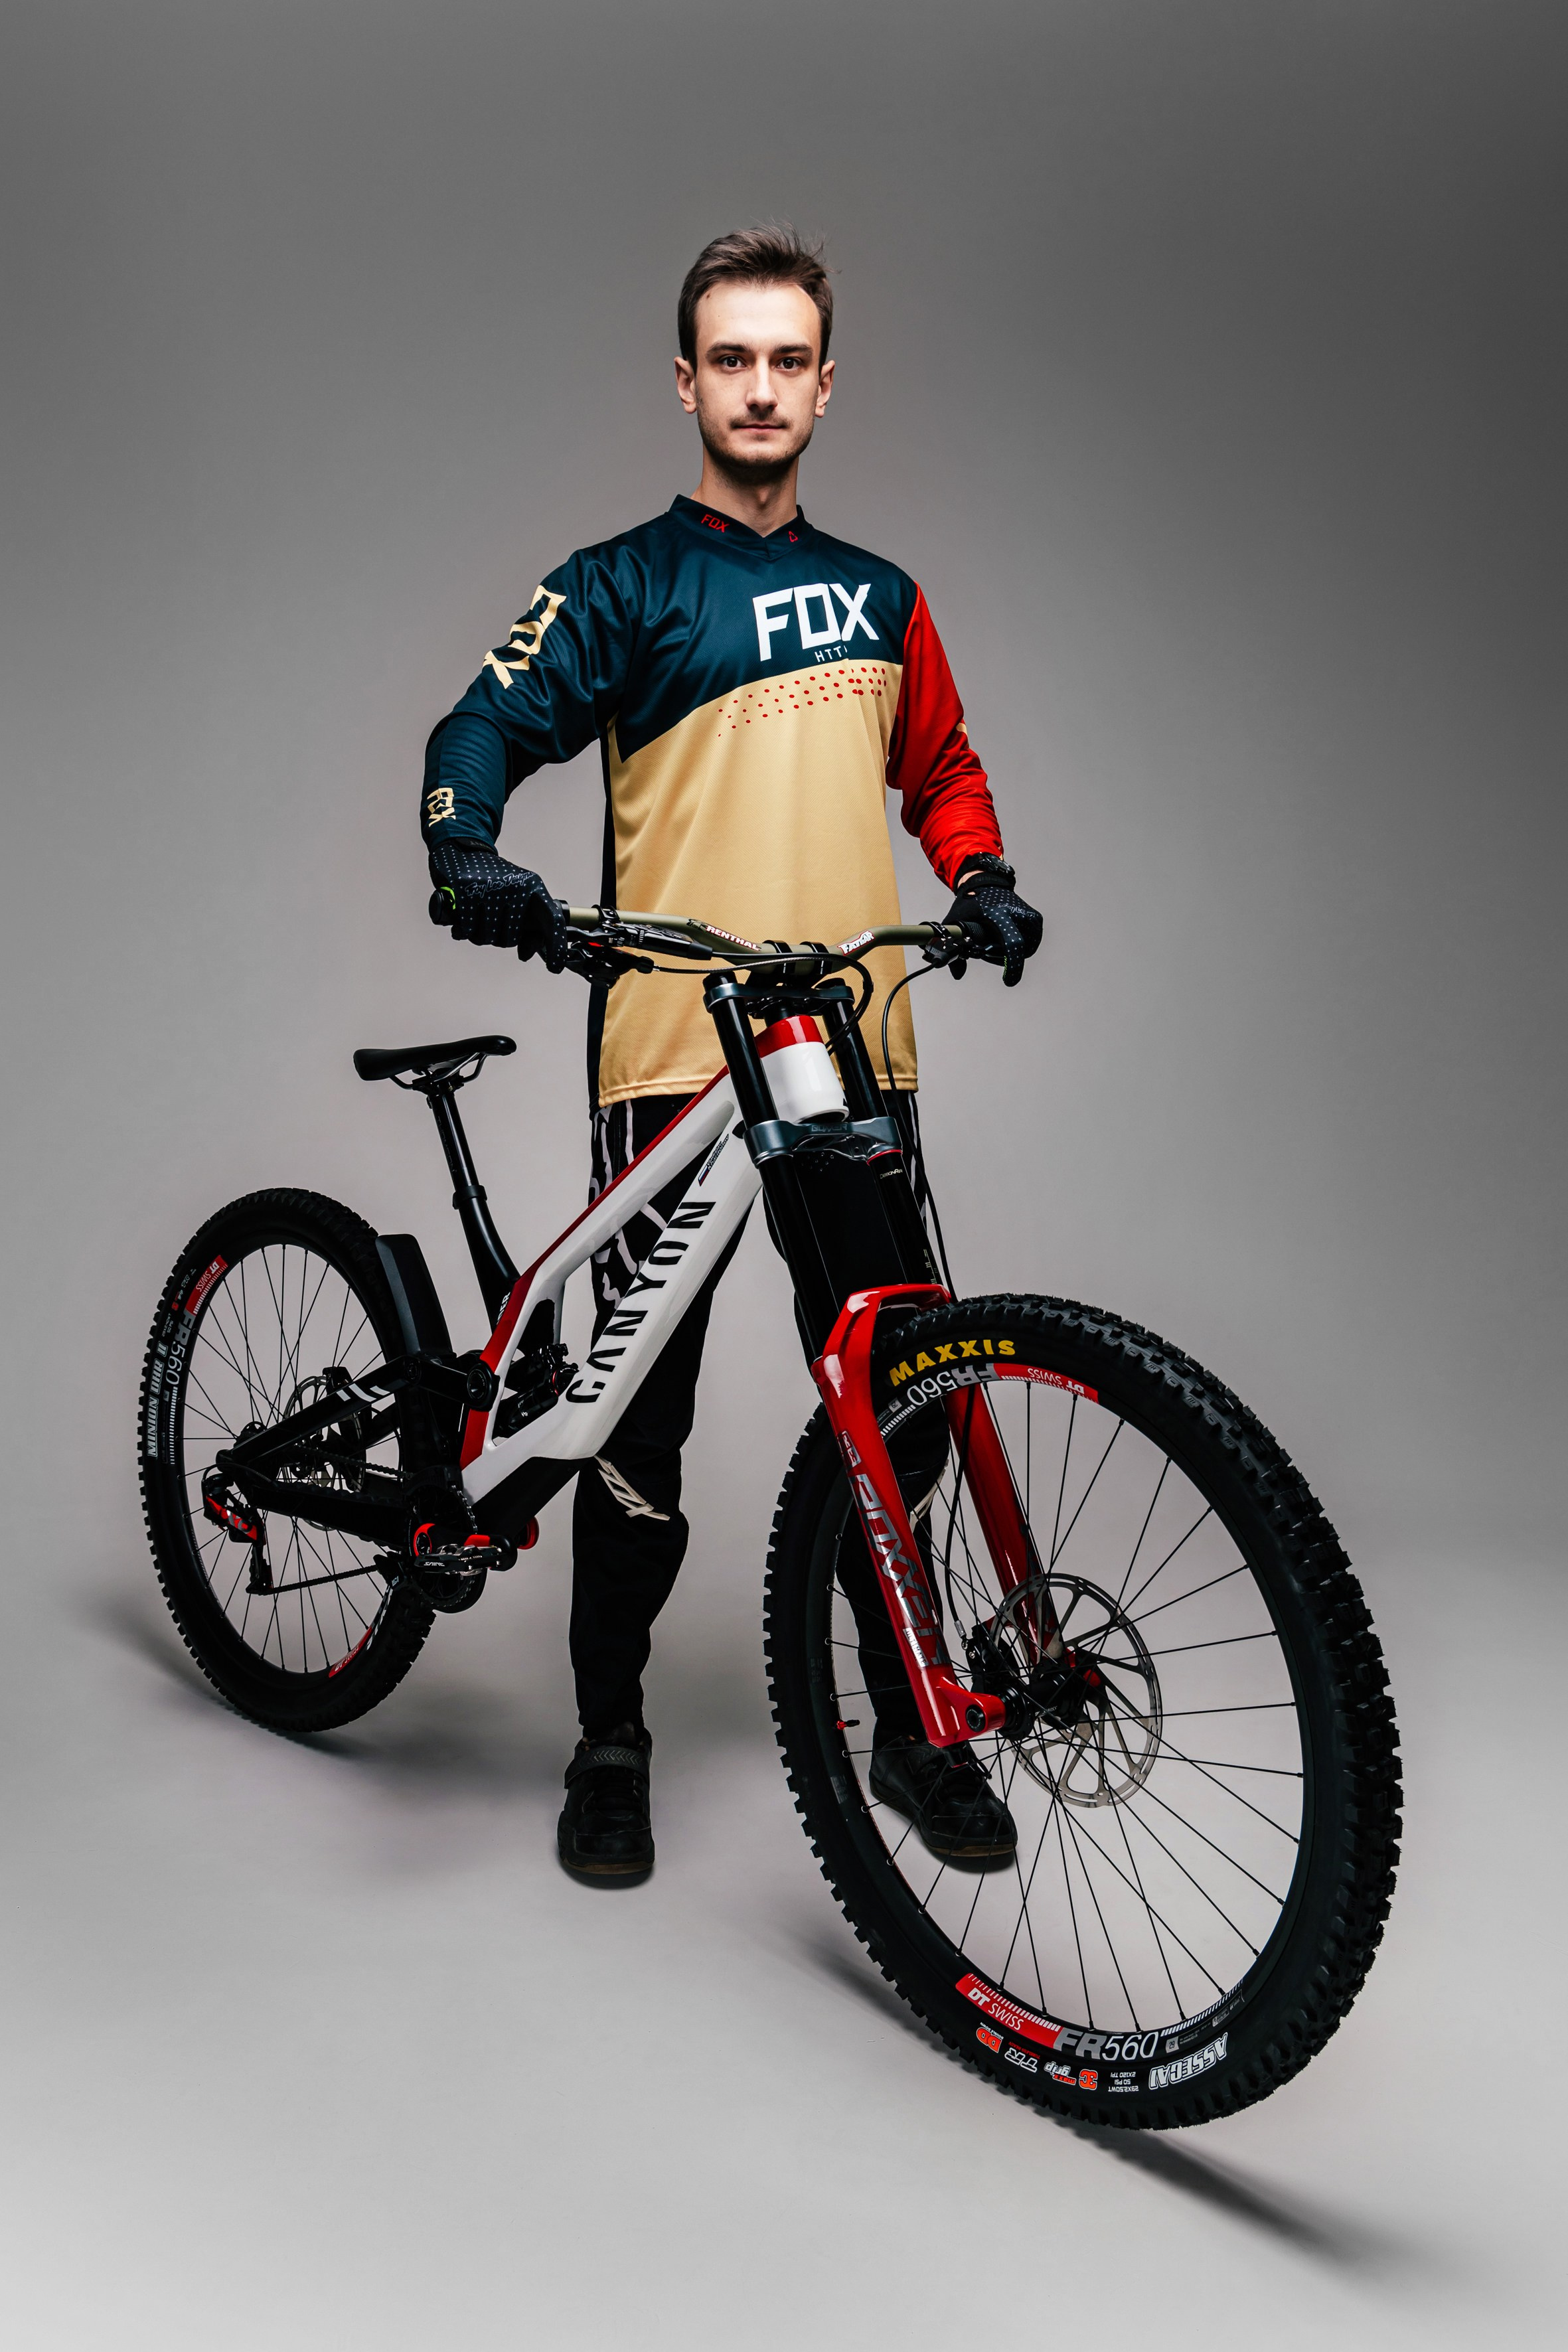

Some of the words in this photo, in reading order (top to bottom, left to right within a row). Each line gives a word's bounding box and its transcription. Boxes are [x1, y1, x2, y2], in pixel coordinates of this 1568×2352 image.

[701, 514, 730, 533] FOX
[752, 583, 880, 662] FOX
[486, 879, 505, 892] Lee
[706, 925, 761, 951] RENTHAL
[209, 1261, 220, 1275] DT
[195, 1271, 211, 1293] SWISS
[565, 1202, 716, 1403] CANYON
[166, 1308, 196, 1386] FR560
[889, 1339, 1016, 1387] MAXXIS
[149, 1358, 165, 1395] DHR
[907, 1363, 1000, 1406] FR560
[1027, 1368, 1063, 1385] SWISS
[1066, 1380, 1085, 1395] DT
[147, 1394, 160, 1458] MINION
[847, 1472, 951, 1666] BOXXER
[905, 1628, 927, 1665] ULTIMATE
[968, 1987, 990, 2006] DT
[988, 2003, 1024, 2031] SWISS
[1053, 2027, 1159, 2061] FR560
[976, 2027, 1002, 2053] DD
[1004, 2047, 1038, 2073] TR
[1044, 2061, 1071, 2077] grip
[1148, 2032, 1228, 2090] ASSEGAI
[1053, 2074, 1077, 2085] maxx
[1079, 2069, 1098, 2090] 3C
